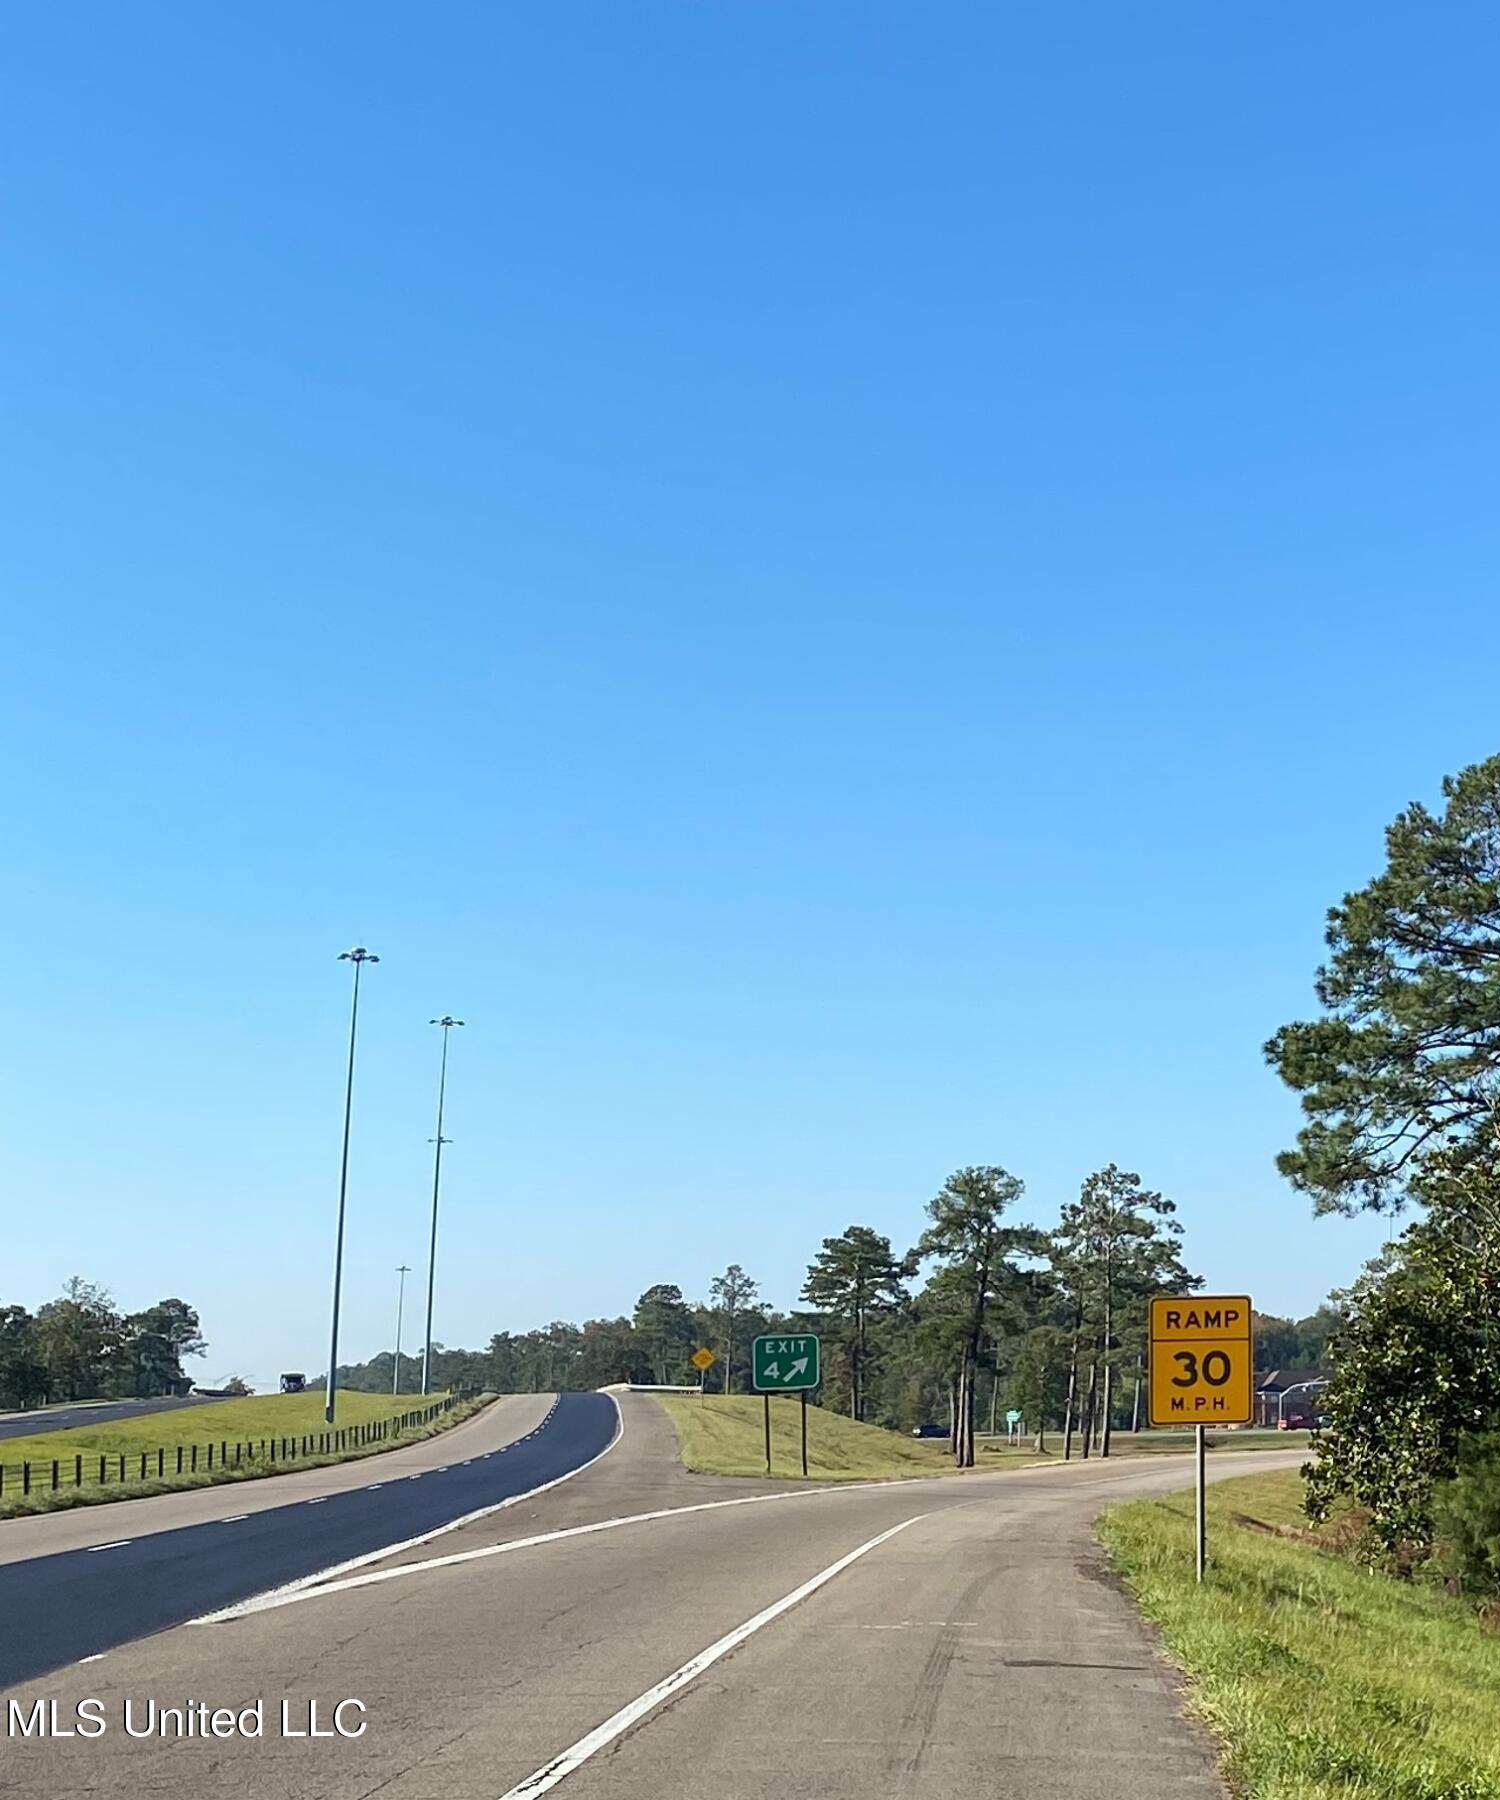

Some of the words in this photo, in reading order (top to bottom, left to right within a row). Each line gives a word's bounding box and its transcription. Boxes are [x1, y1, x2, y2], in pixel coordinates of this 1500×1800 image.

[1166, 1310, 1239, 1328] RAMP
[765, 1340, 806, 1354] EXIT
[763, 1361, 780, 1379] 4
[1171, 1350, 1231, 1387] 30
[1171, 1397, 1231, 1411] M.P.H.
